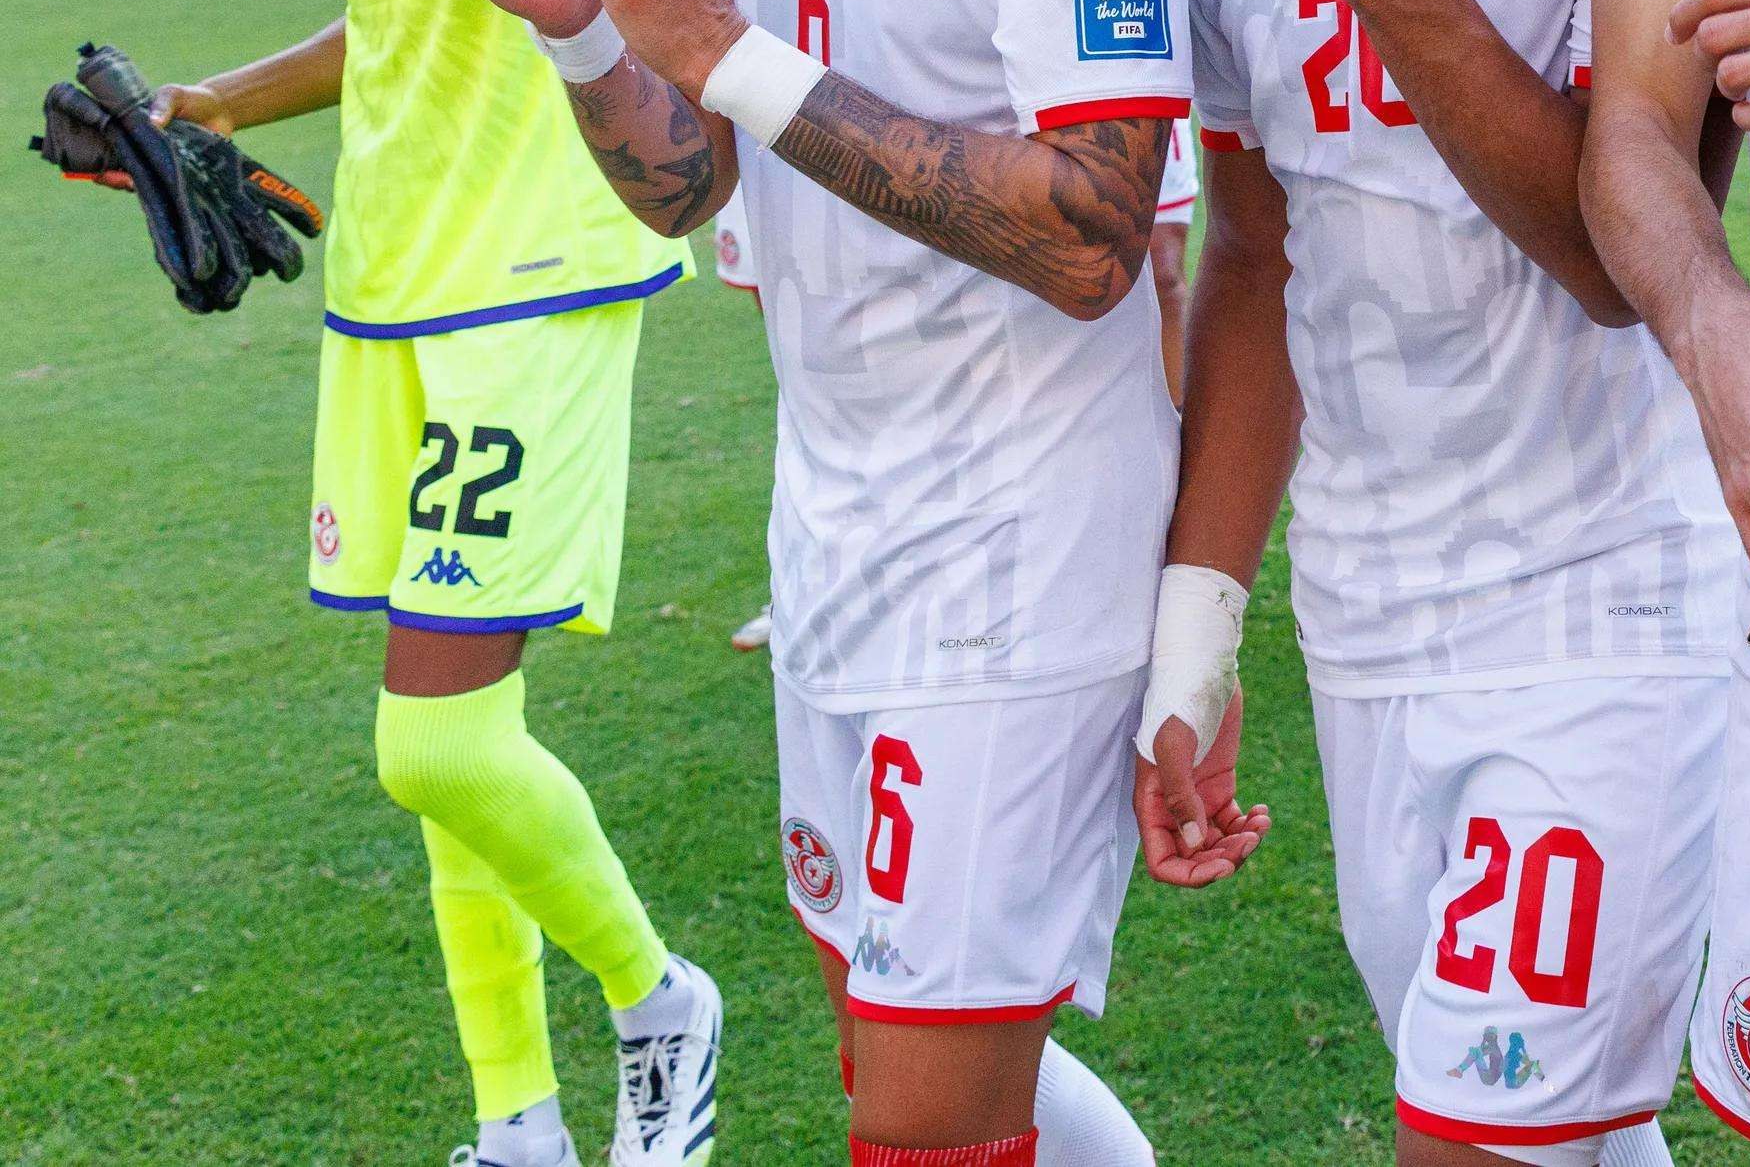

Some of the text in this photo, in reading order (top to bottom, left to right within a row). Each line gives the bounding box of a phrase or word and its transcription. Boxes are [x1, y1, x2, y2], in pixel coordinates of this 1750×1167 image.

[1095, 1, 1155, 20] the World
[1118, 26, 1141, 35] FIFA
[410, 422, 525, 538] 22
[1608, 606, 1671, 616] KOMBAT
[939, 636, 996, 648] KOMBAT
[866, 734, 922, 904] 6
[1436, 817, 1604, 1008] 20
